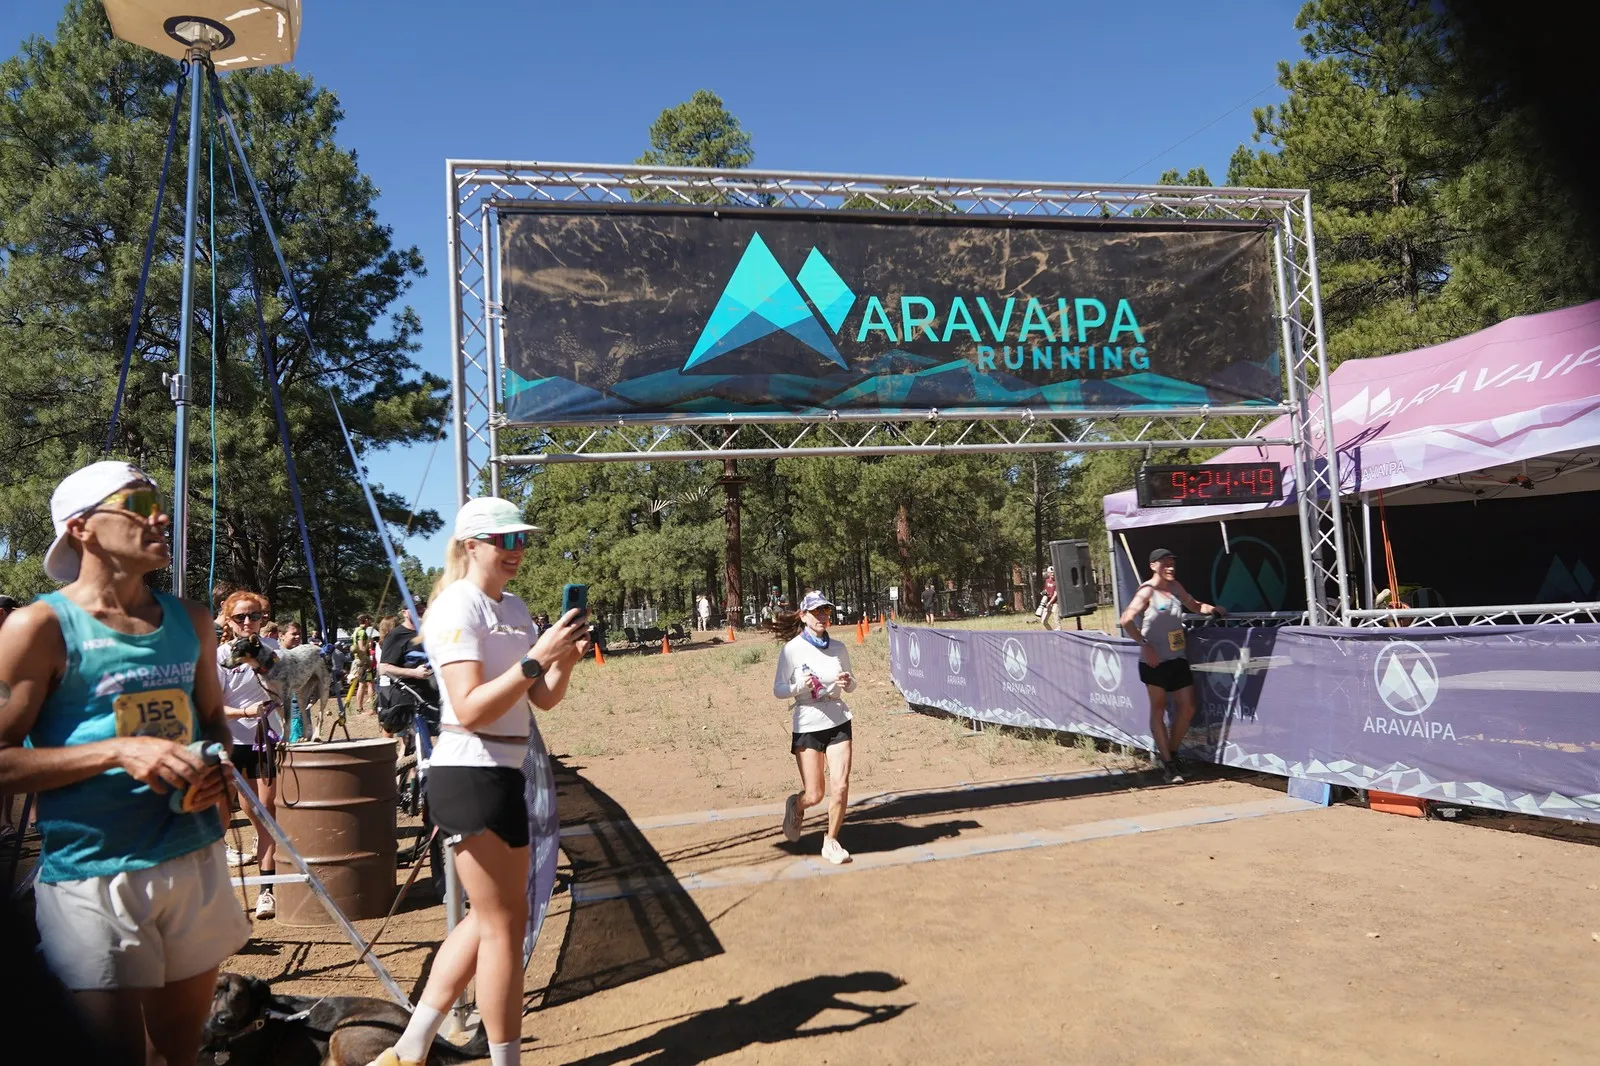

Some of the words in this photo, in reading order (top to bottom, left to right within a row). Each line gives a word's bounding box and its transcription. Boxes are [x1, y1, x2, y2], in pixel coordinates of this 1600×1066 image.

[856, 295, 1146, 343] ARAVAIPA
[977, 345, 1150, 371] RUNNING
[1367, 344, 1600, 424] ARAVAIP
[142, 676, 180, 688] RACING
[137, 700, 176, 723] 152
[1089, 693, 1133, 709] ARAVAIPA
[1362, 716, 1456, 741] ARAVAIPA
